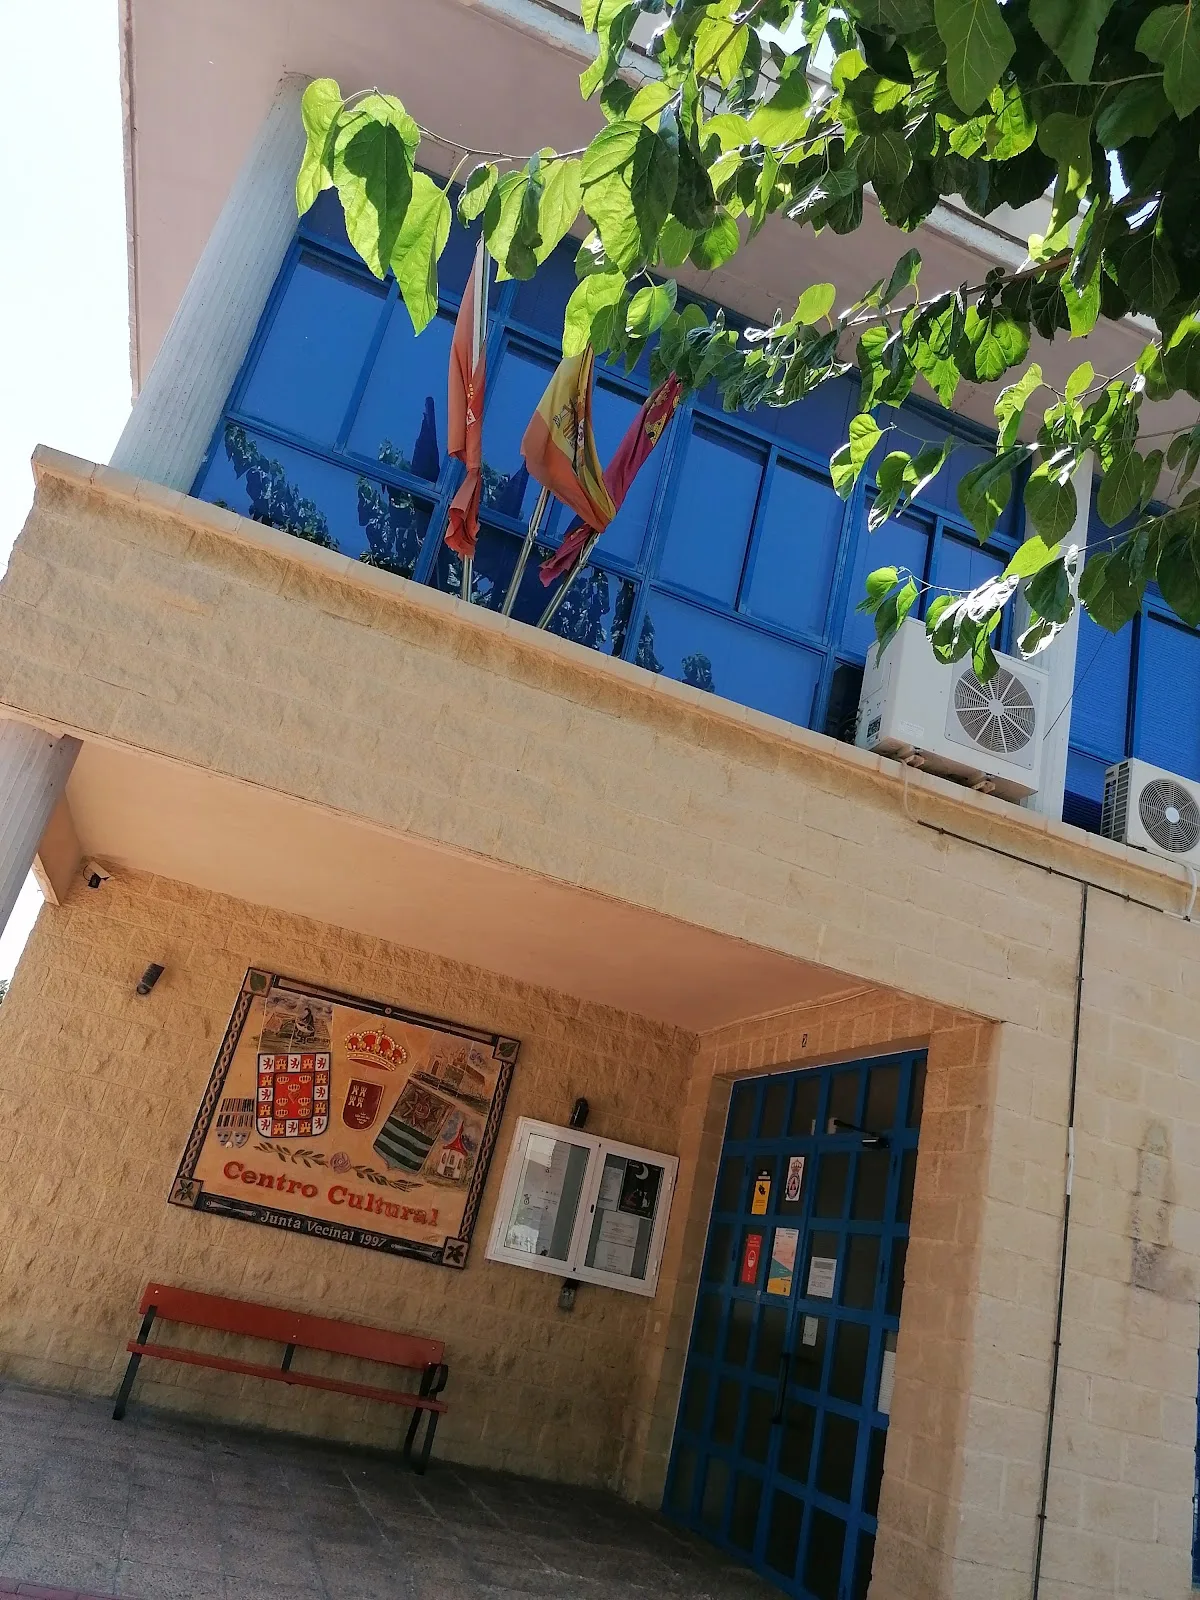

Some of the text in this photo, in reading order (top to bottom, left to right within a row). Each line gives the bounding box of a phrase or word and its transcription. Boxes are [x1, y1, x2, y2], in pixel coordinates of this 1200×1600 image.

[223, 1161, 439, 1226] Centro Cultural
[260, 1211, 387, 1248] Junta Vecinal 1997
